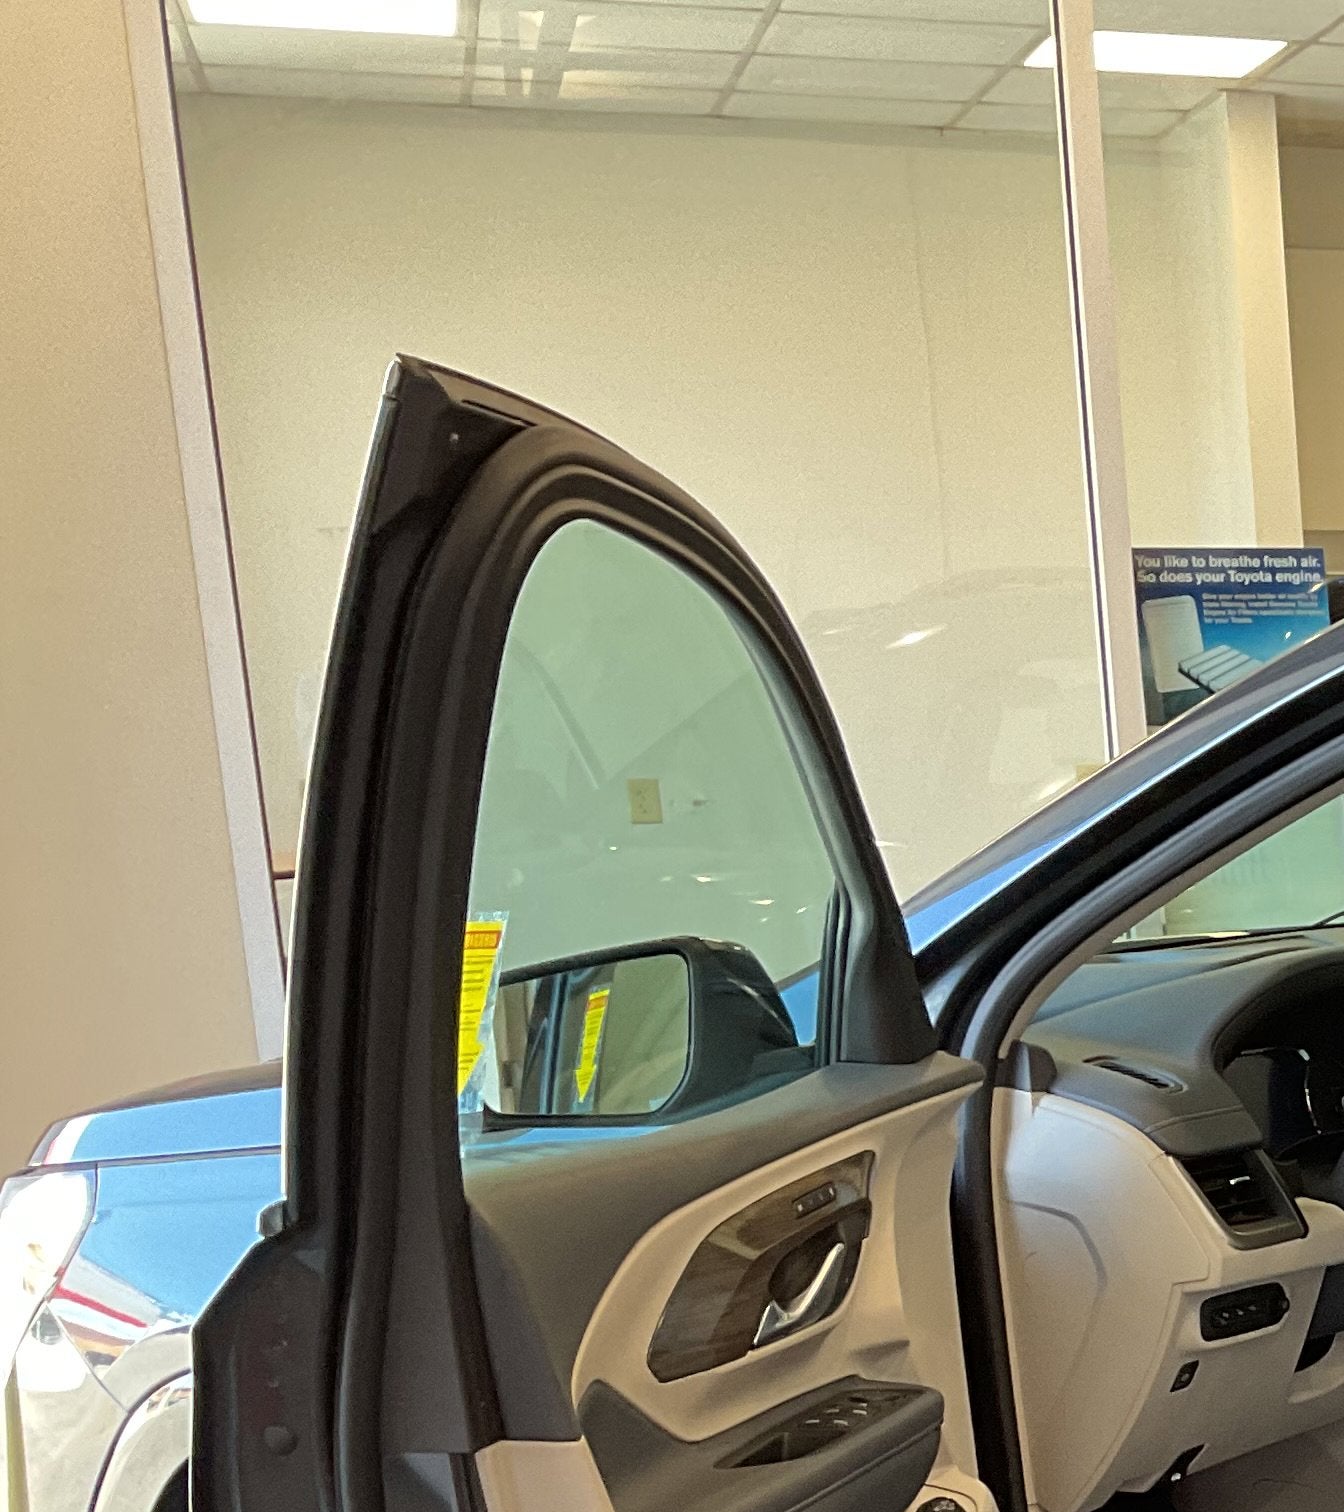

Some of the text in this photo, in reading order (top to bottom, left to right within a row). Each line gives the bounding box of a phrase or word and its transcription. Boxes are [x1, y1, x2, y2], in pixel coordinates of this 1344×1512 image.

[1134, 555, 1321, 568] You like to breathe fresh air.
[1137, 571, 1156, 583] So
[1159, 571, 1193, 583] does
[1195, 573, 1226, 585] your
[1228, 571, 1273, 585] Toyota
